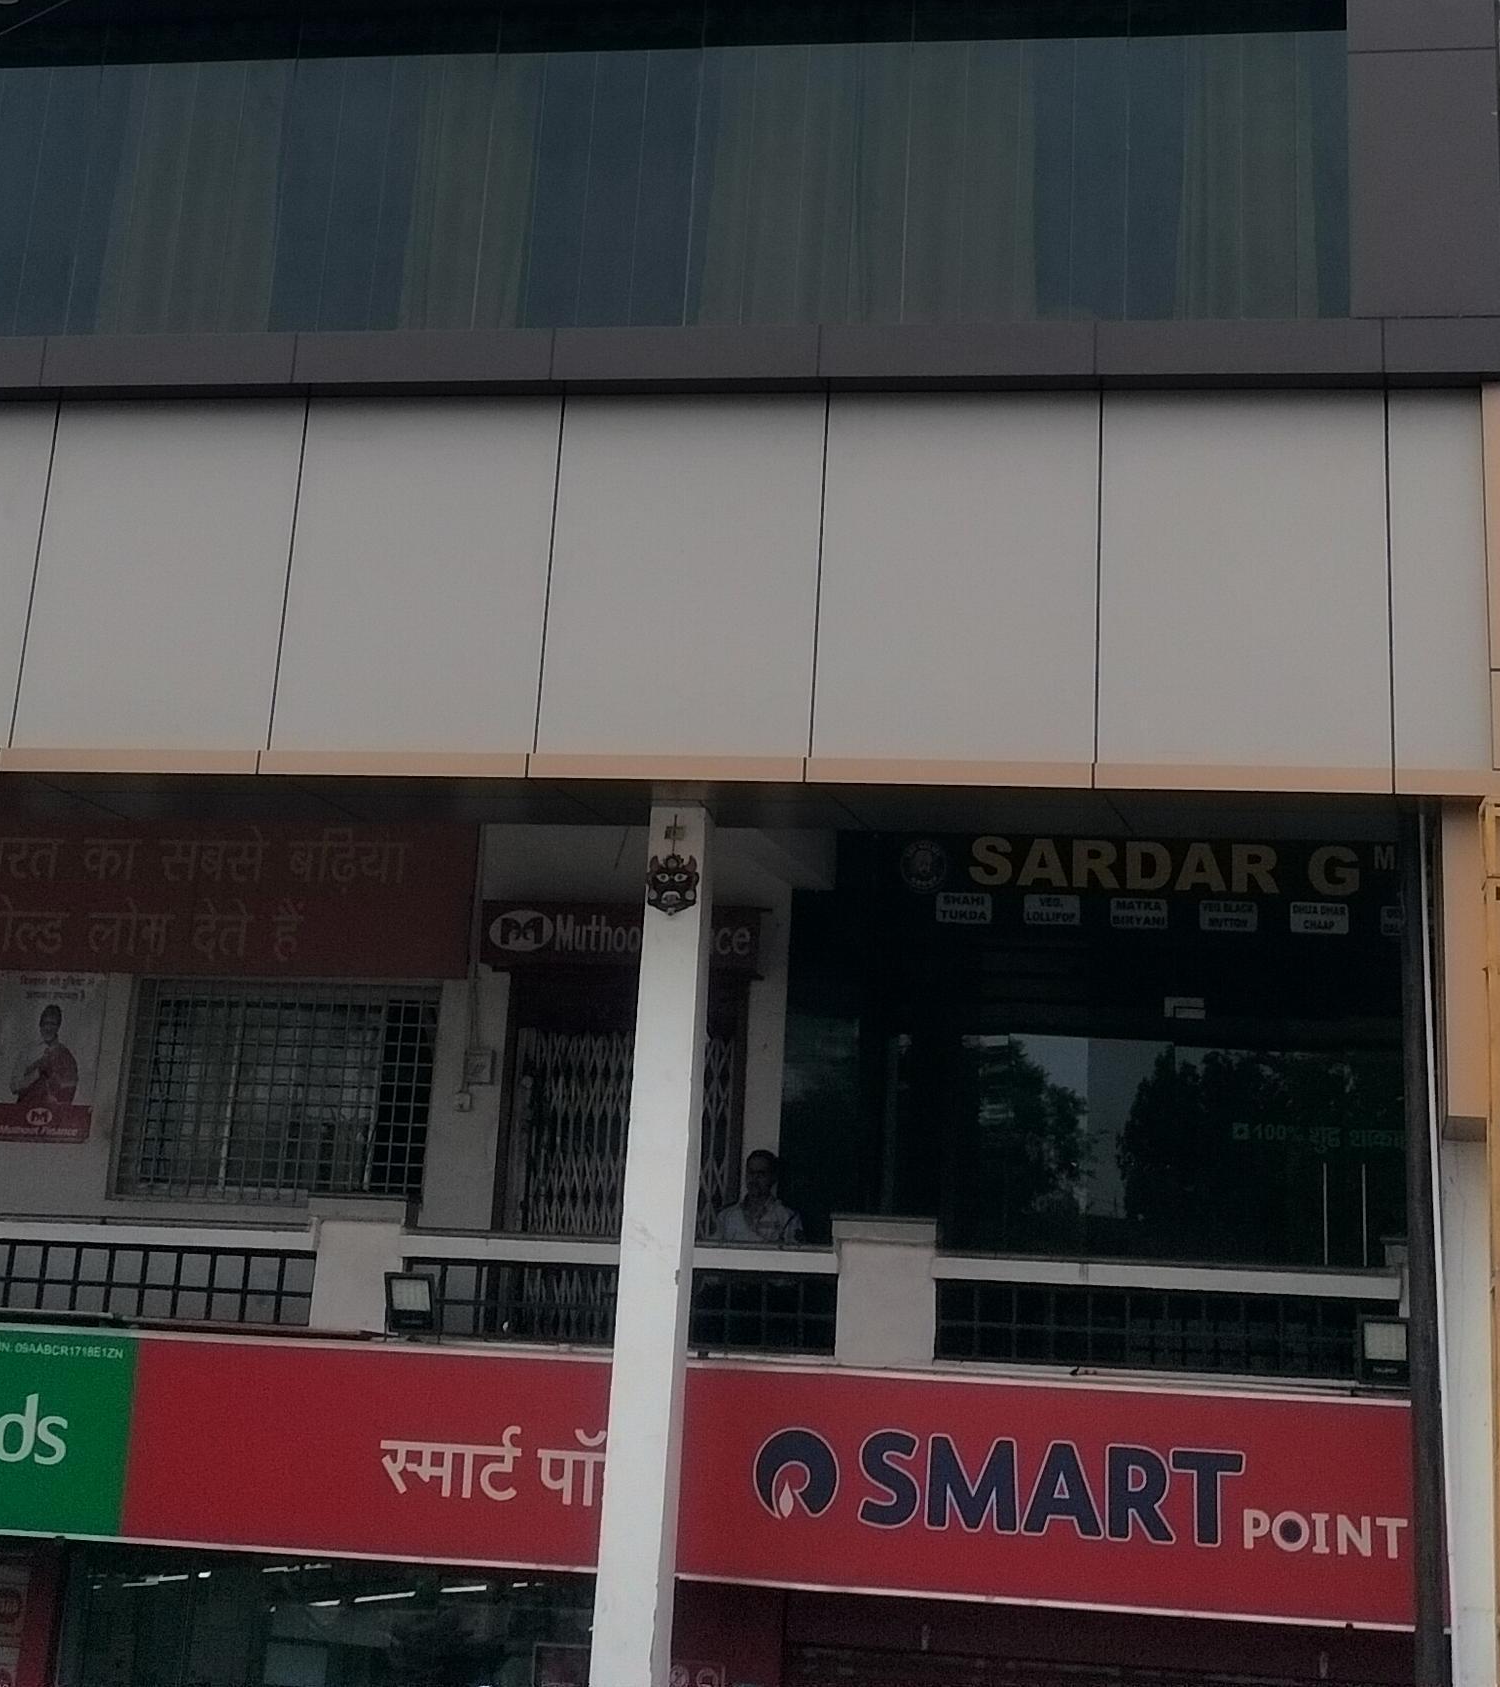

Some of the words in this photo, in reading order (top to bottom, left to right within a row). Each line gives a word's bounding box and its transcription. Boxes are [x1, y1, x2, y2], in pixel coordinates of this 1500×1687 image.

[84, 836, 143, 883] का
[159, 824, 270, 884] सबसे
[968, 836, 1280, 895] SARDAR
[1307, 844, 1360, 896] G
[555, 914, 641, 953] Muthoo
[380, 1425, 522, 1502] स्मार्ट
[856, 1427, 1246, 1550] SMART
[1243, 1508, 1408, 1561] POINT
